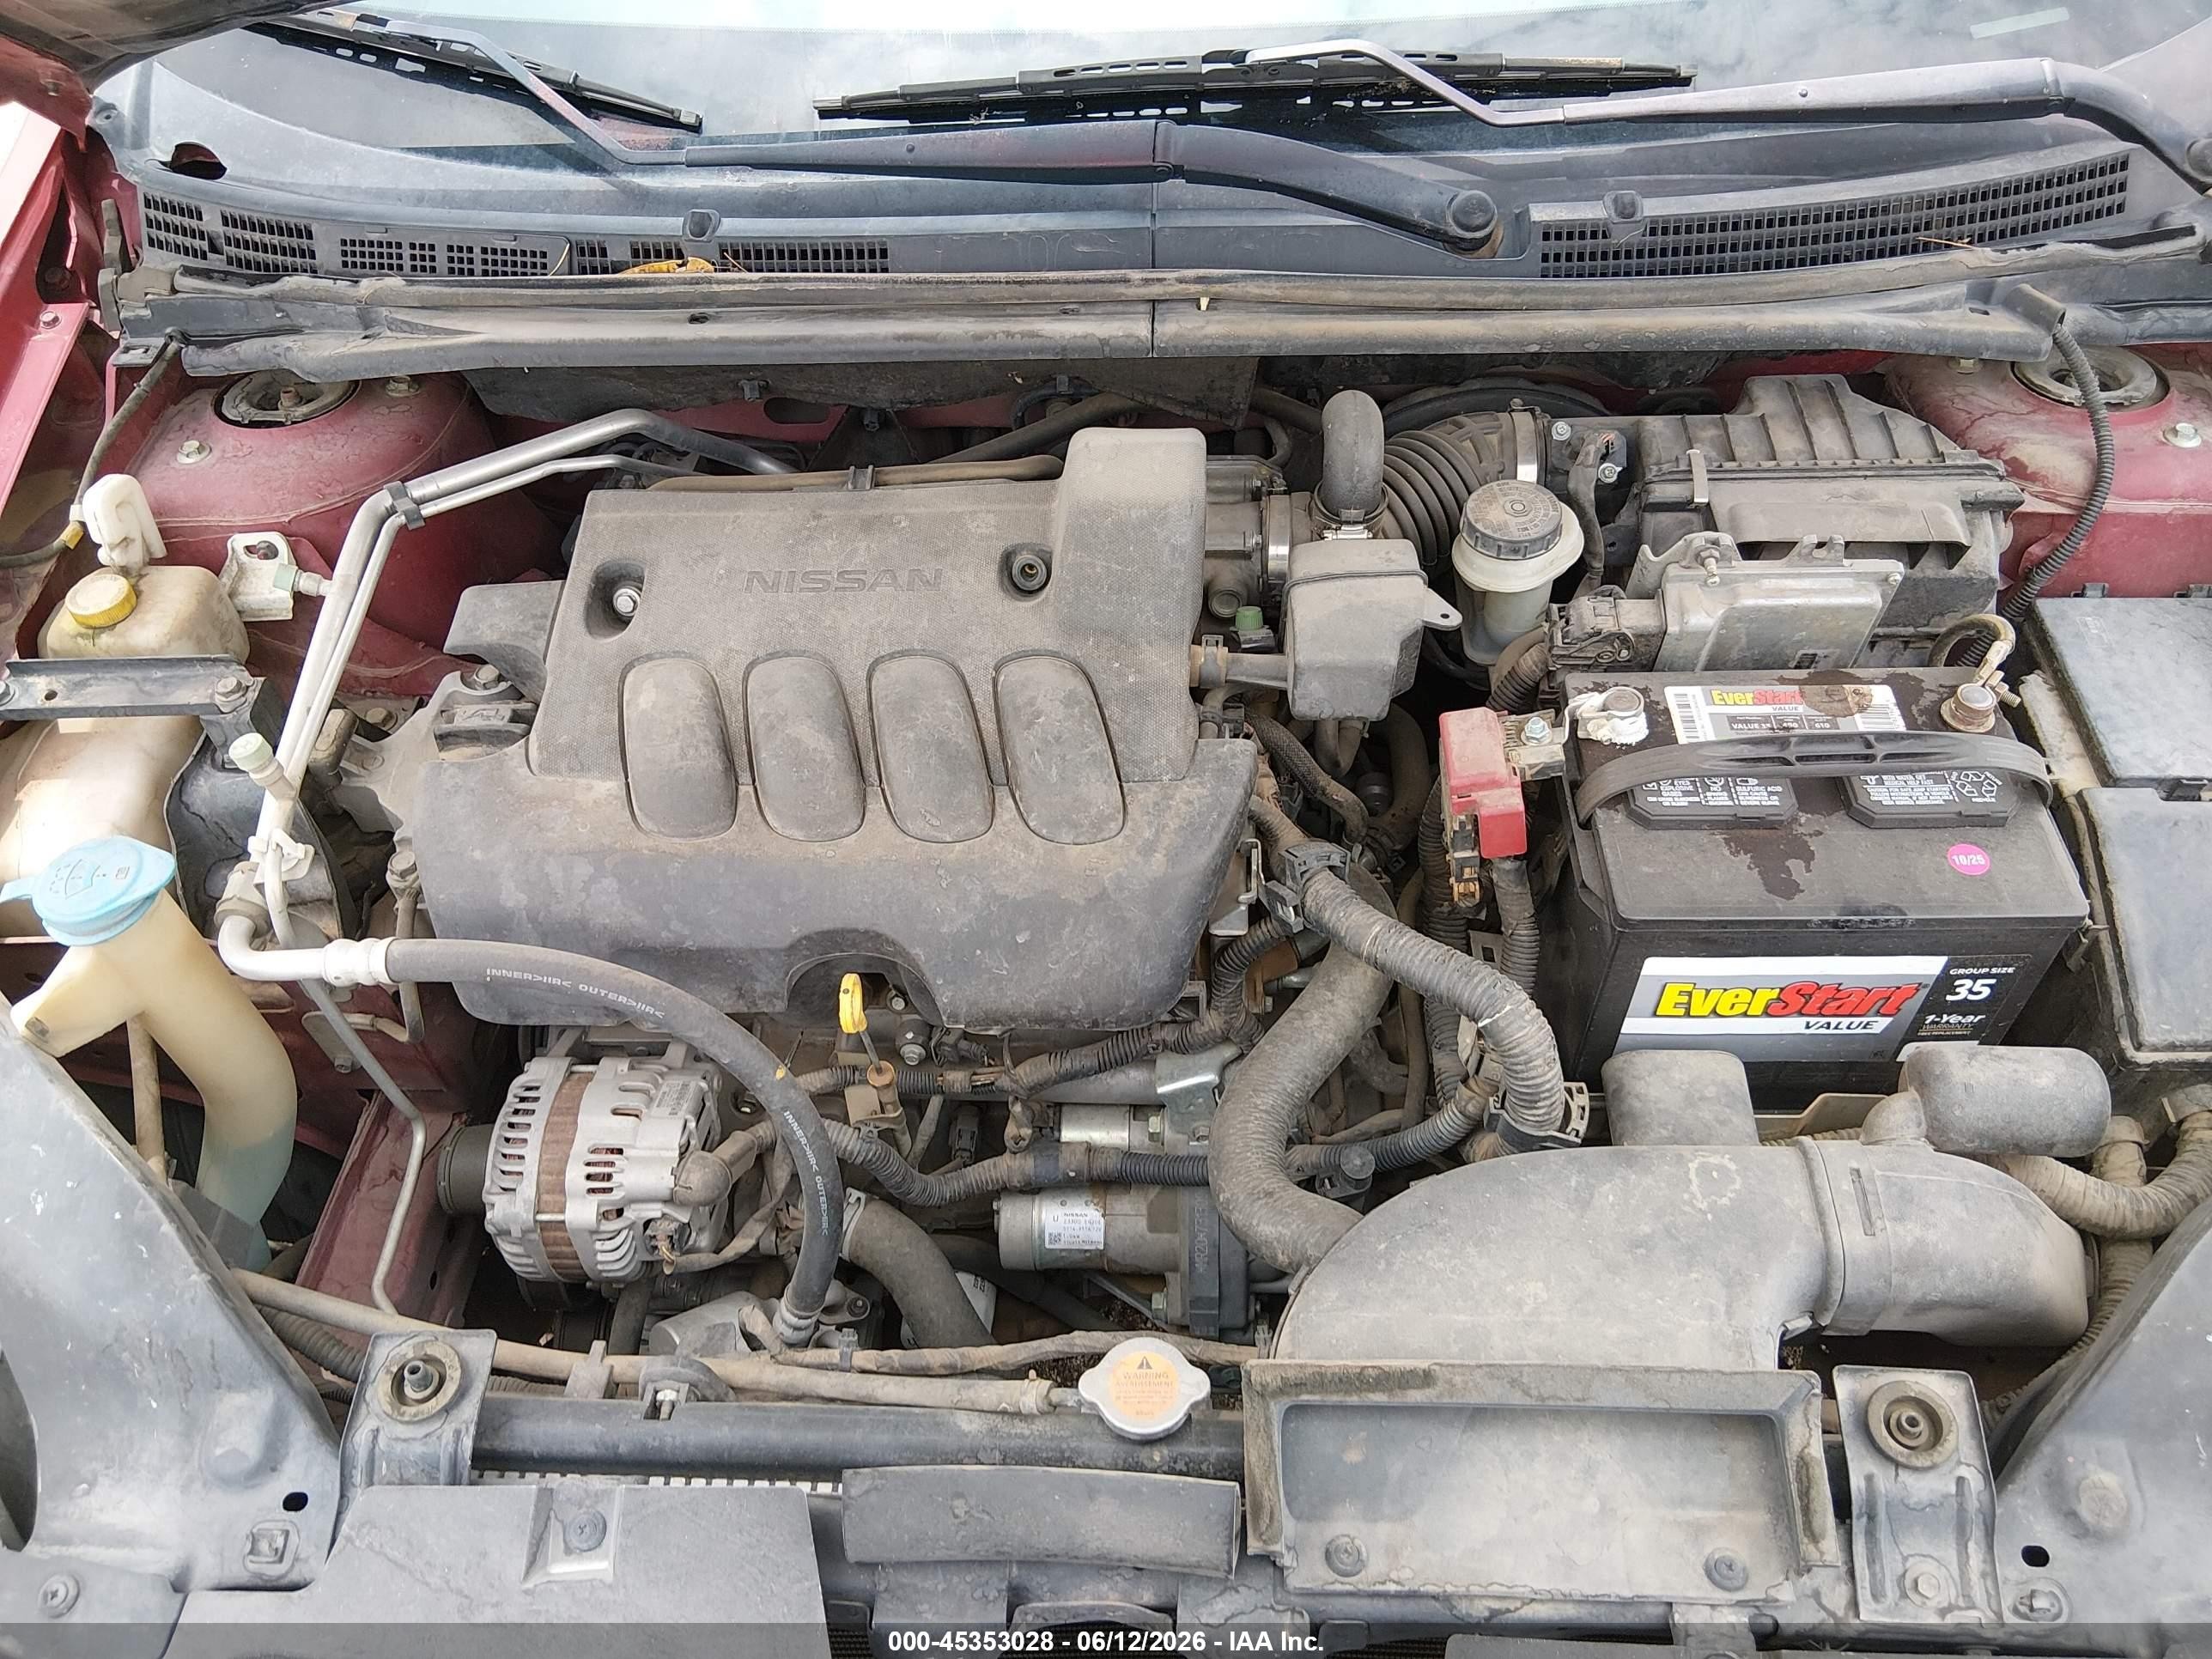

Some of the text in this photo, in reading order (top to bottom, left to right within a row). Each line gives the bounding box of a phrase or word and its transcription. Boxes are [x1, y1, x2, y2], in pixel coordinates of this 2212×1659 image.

[743, 568, 944, 593] NISSAN
[1710, 690, 1803, 705] EverStart
[1951, 854, 1985, 866] 10/25
[1945, 978, 1996, 1001] 35
[1656, 981, 1923, 1018] EverStart
[1802, 1020, 1879, 1030] VALUE
[1924, 1014, 1986, 1024] 1-Year
[1122, 1371, 1169, 1380] WARNING
